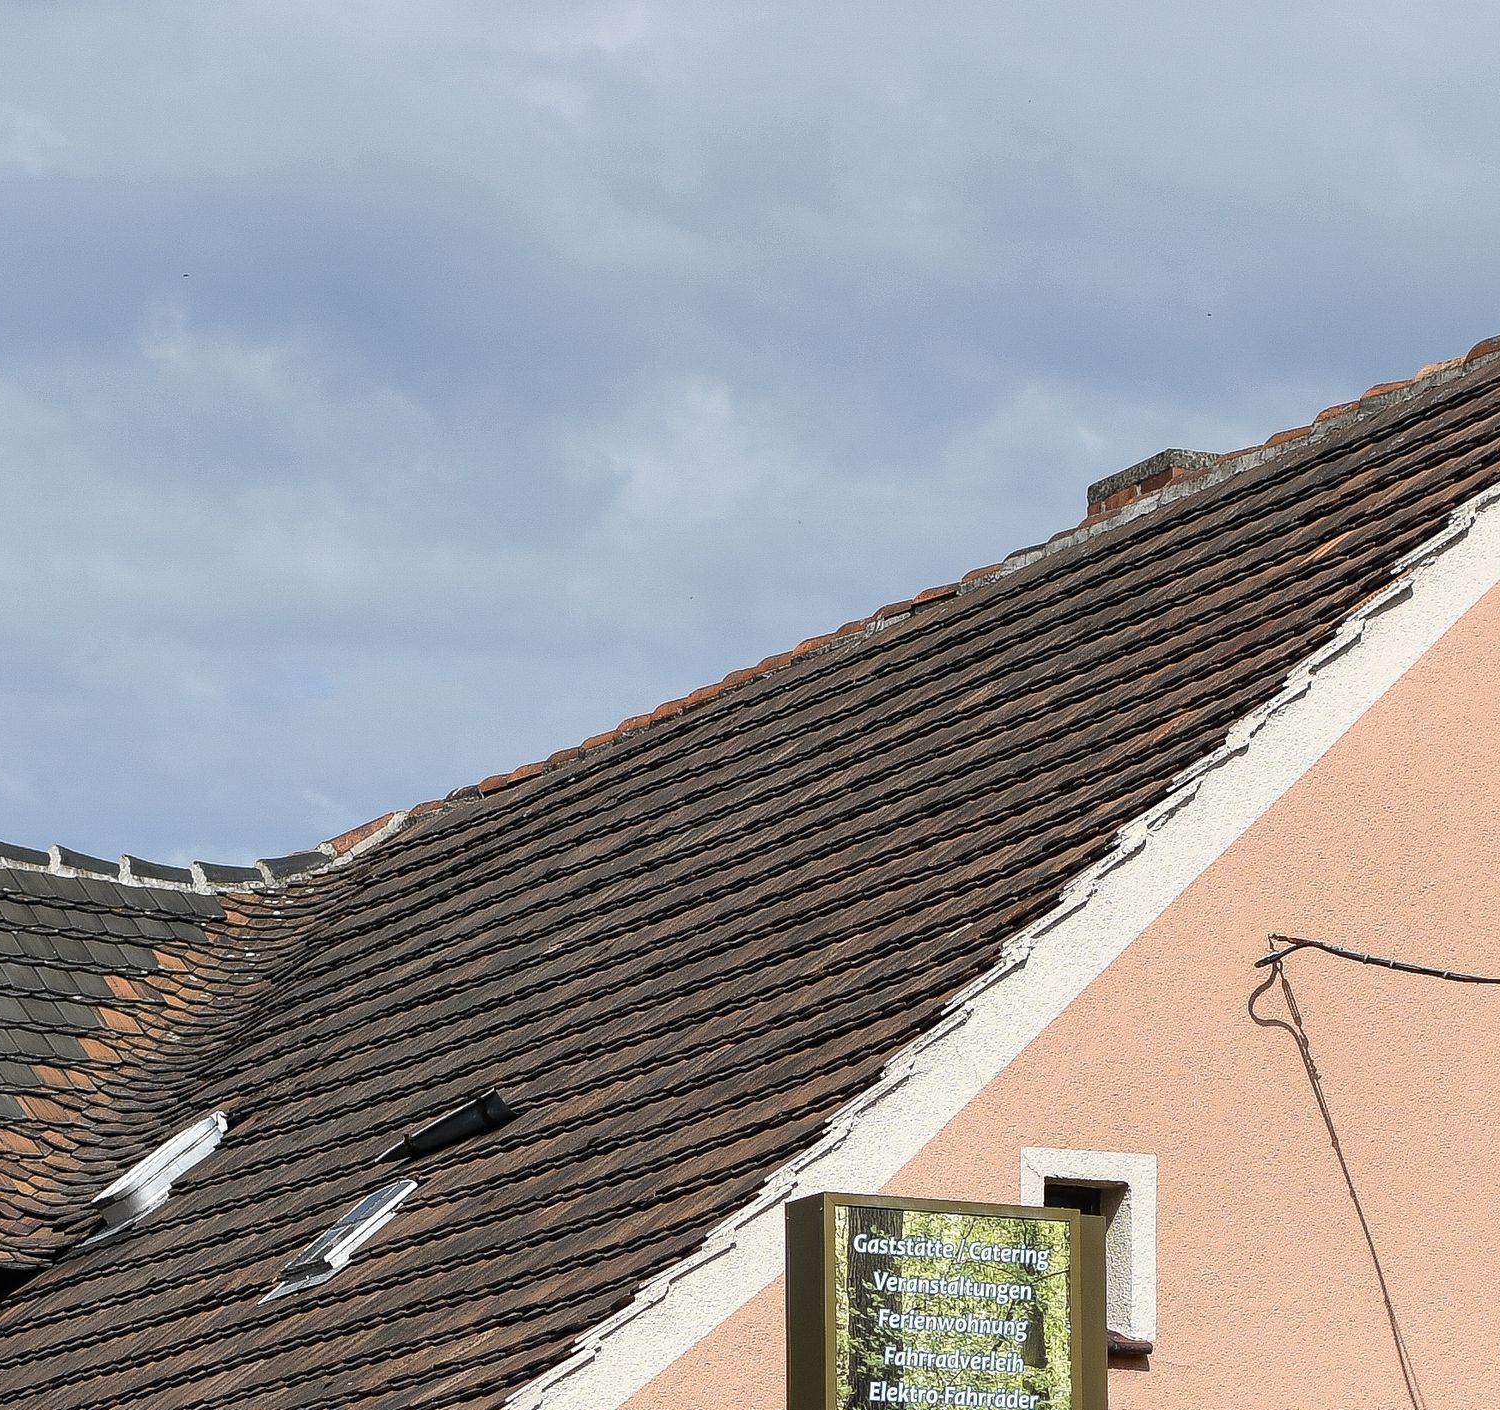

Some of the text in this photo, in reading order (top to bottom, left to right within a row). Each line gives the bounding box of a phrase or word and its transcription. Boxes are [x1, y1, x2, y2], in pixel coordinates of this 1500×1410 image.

[853, 1234, 954, 1258] Gaststätte
[969, 1241, 1050, 1271] Catering
[873, 1270, 1033, 1305] Veranstaltungen
[878, 1308, 1029, 1343] Ferienwohnung
[884, 1346, 1025, 1373] Fahrradverleih
[869, 1380, 1040, 1410] Elektro-Fahrräder
